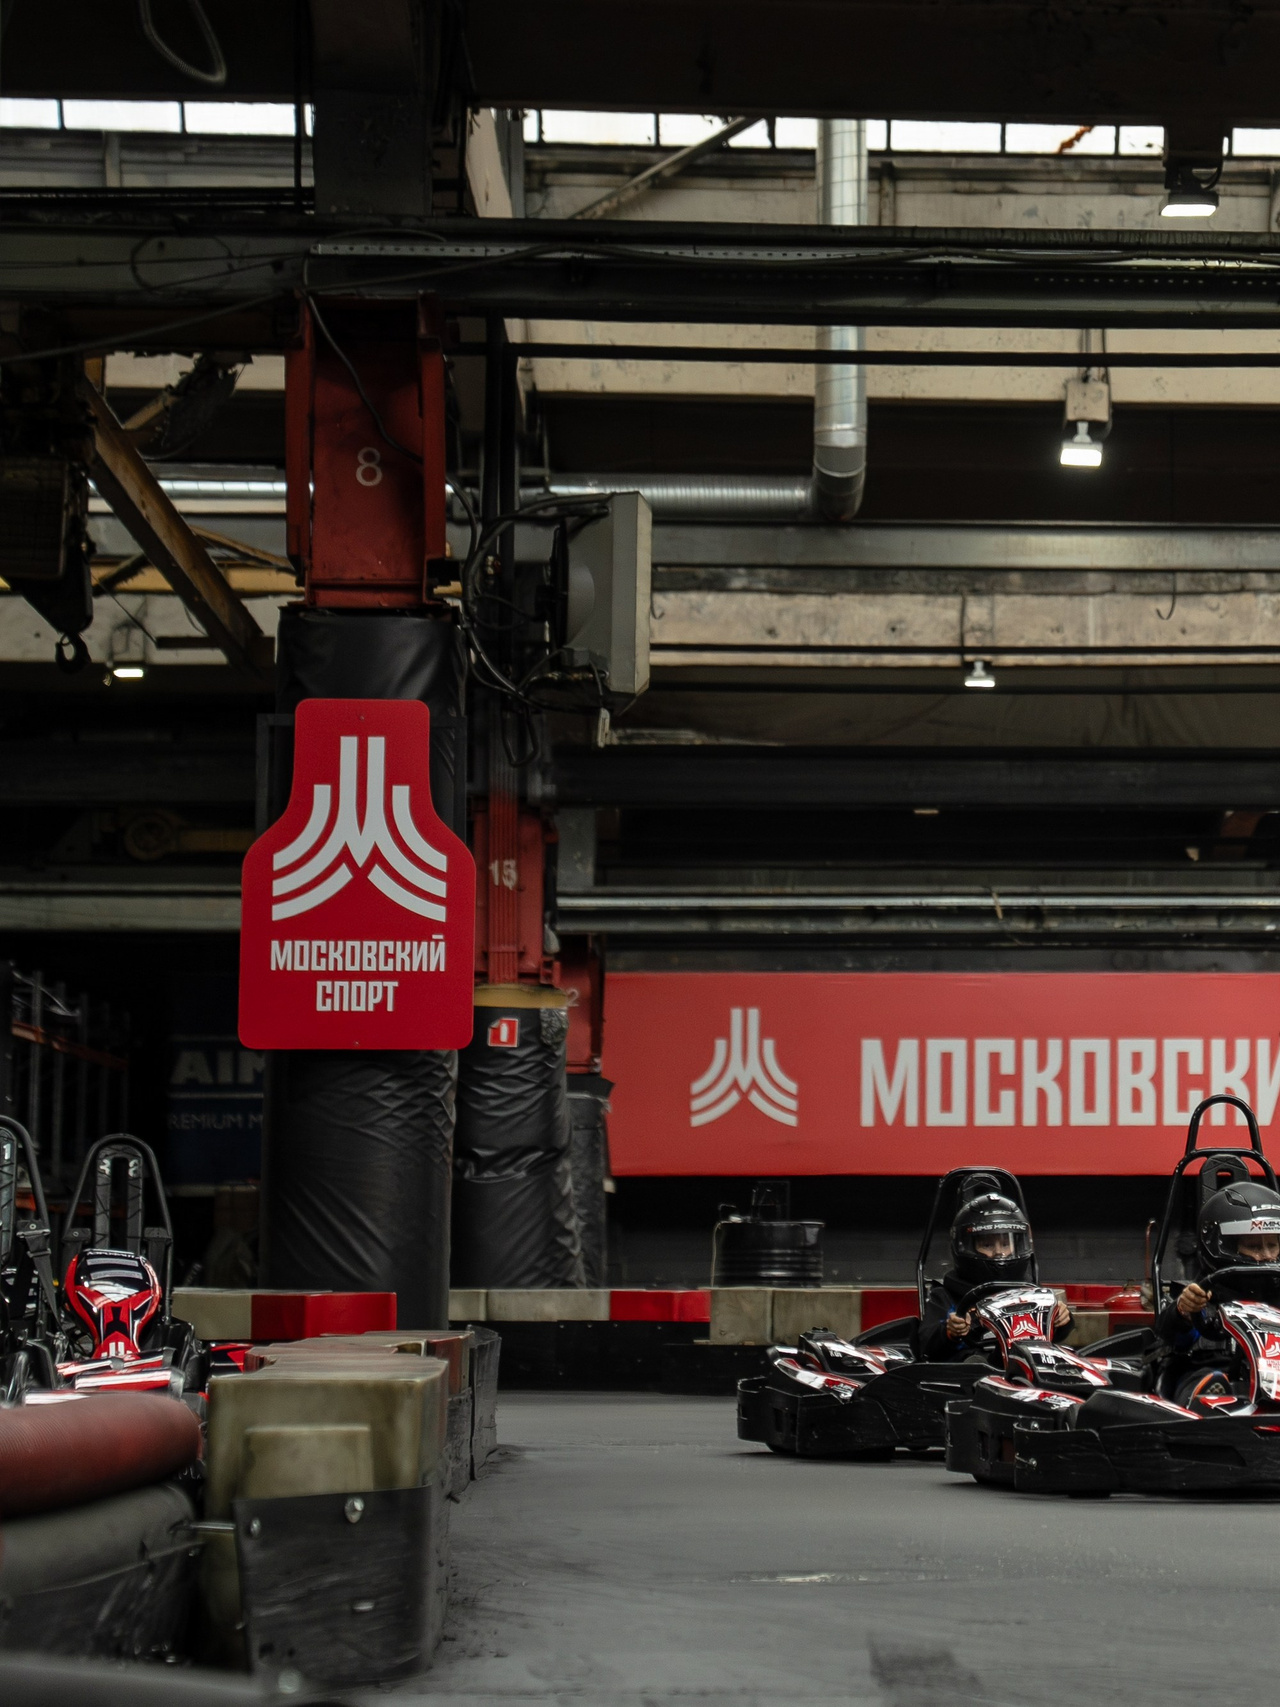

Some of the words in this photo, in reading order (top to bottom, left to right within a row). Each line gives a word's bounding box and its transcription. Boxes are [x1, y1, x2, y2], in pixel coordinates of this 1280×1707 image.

[356, 446, 382, 486] 8
[270, 934, 446, 972] МОСКОВСКИЙ
[316, 980, 399, 1012] СПОРТ
[165, 1112, 244, 1130] REMIUM
